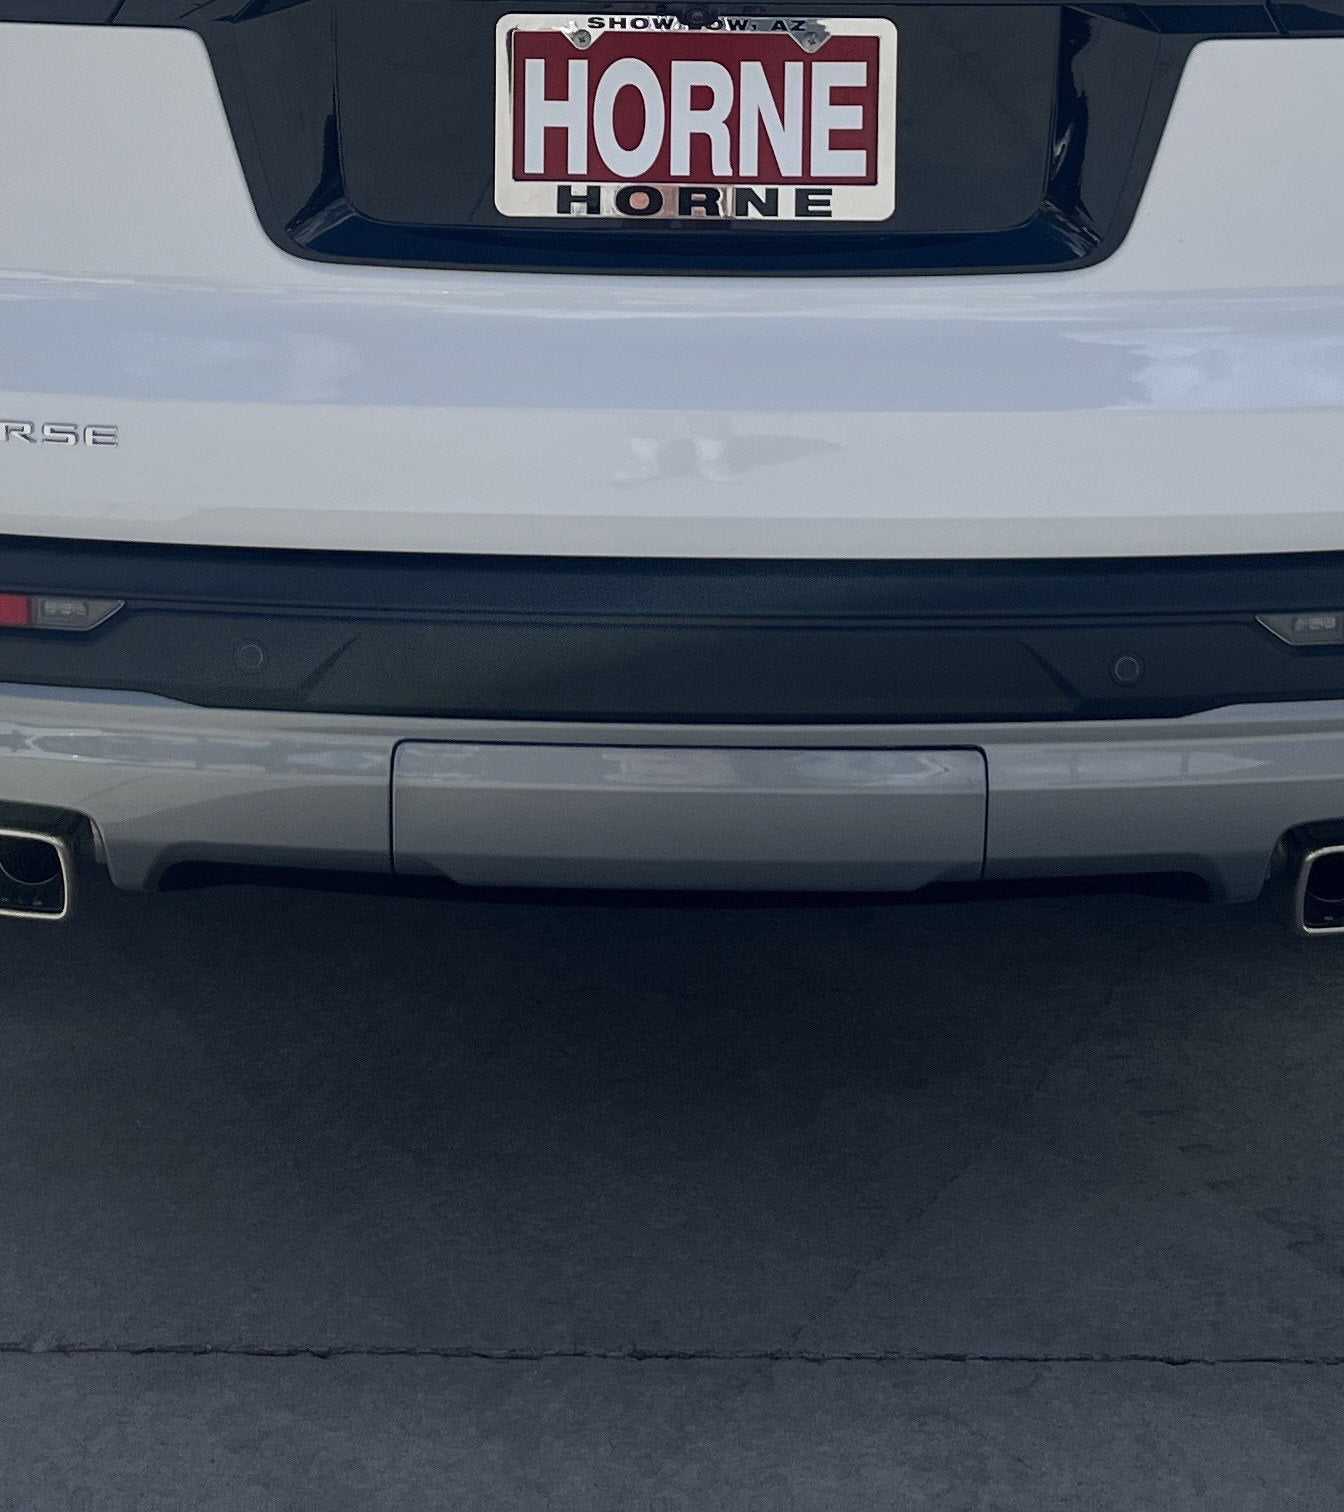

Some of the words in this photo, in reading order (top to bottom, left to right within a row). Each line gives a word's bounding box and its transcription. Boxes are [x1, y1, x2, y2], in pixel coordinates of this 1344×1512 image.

[587, 16, 676, 30] SHOW
[771, 20, 807, 32] AZ
[524, 57, 868, 178] HORNE
[557, 185, 833, 217] HORNE
